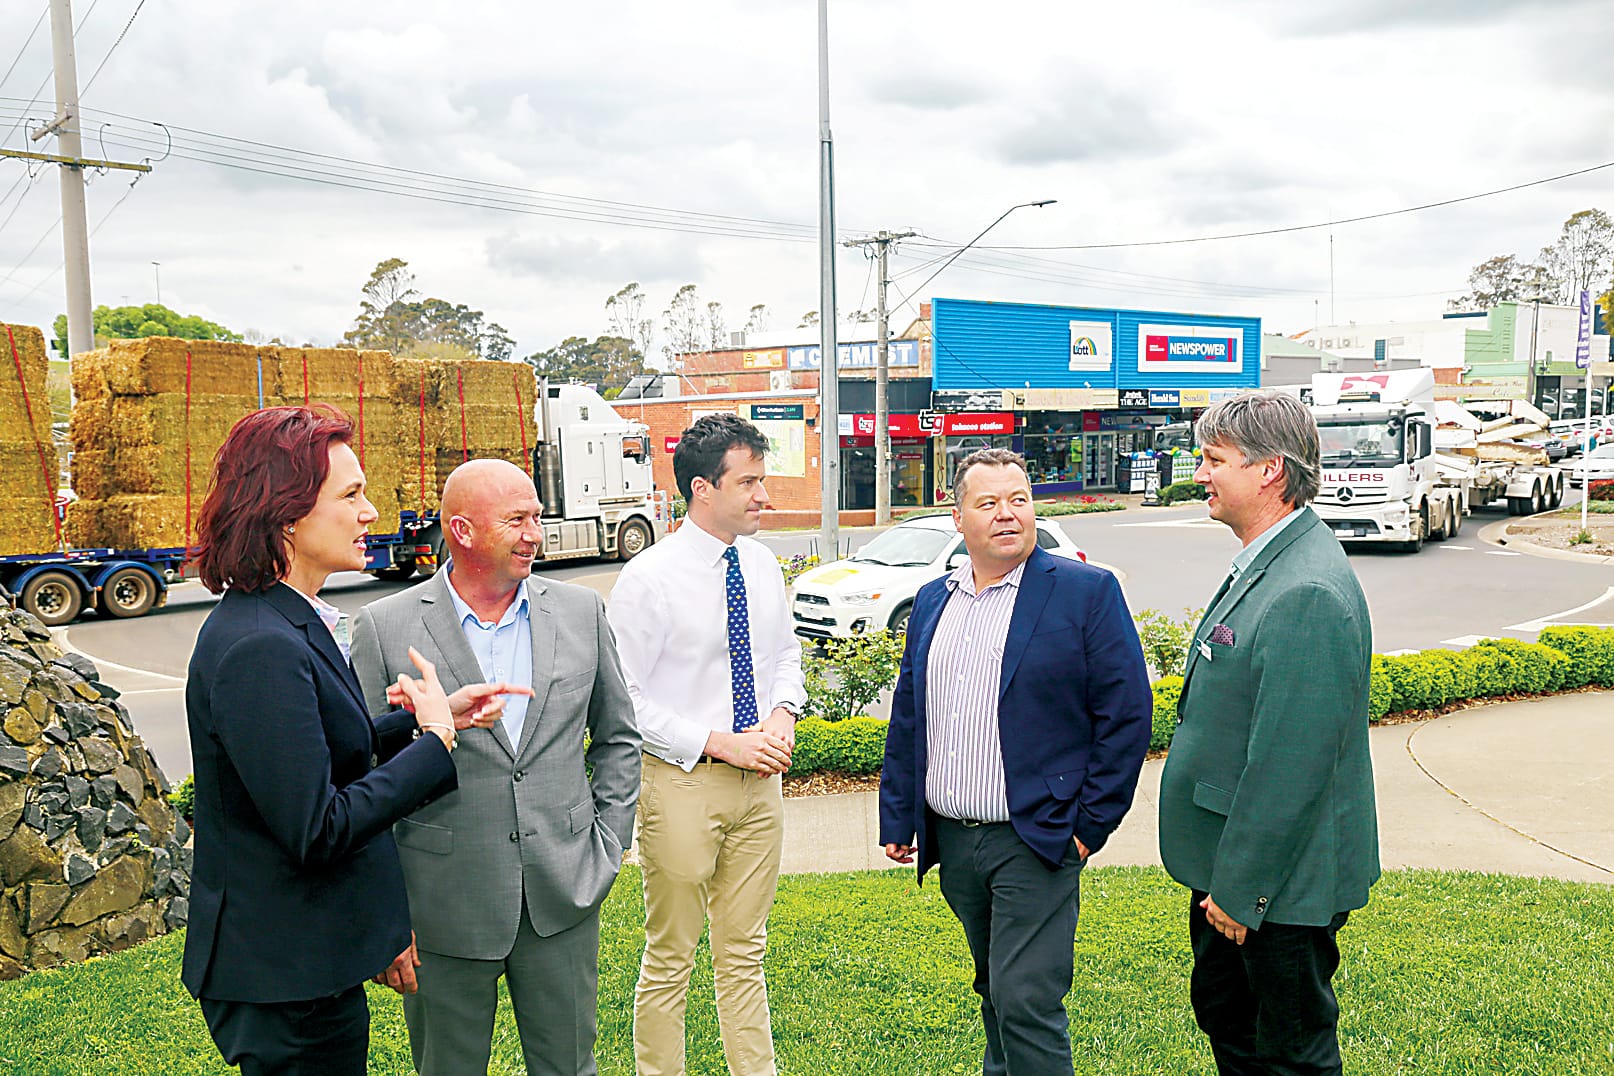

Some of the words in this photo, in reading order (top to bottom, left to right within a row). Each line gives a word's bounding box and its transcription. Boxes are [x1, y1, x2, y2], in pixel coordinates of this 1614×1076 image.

[808, 344, 913, 366] CEMIST
[1169, 342, 1226, 356] NEWSPOWER
[1151, 394, 1168, 403] Herald
[919, 409, 945, 436] tsg
[951, 422, 979, 431] tobacco
[980, 421, 1004, 431] station
[1323, 473, 1384, 482] ILLERS
